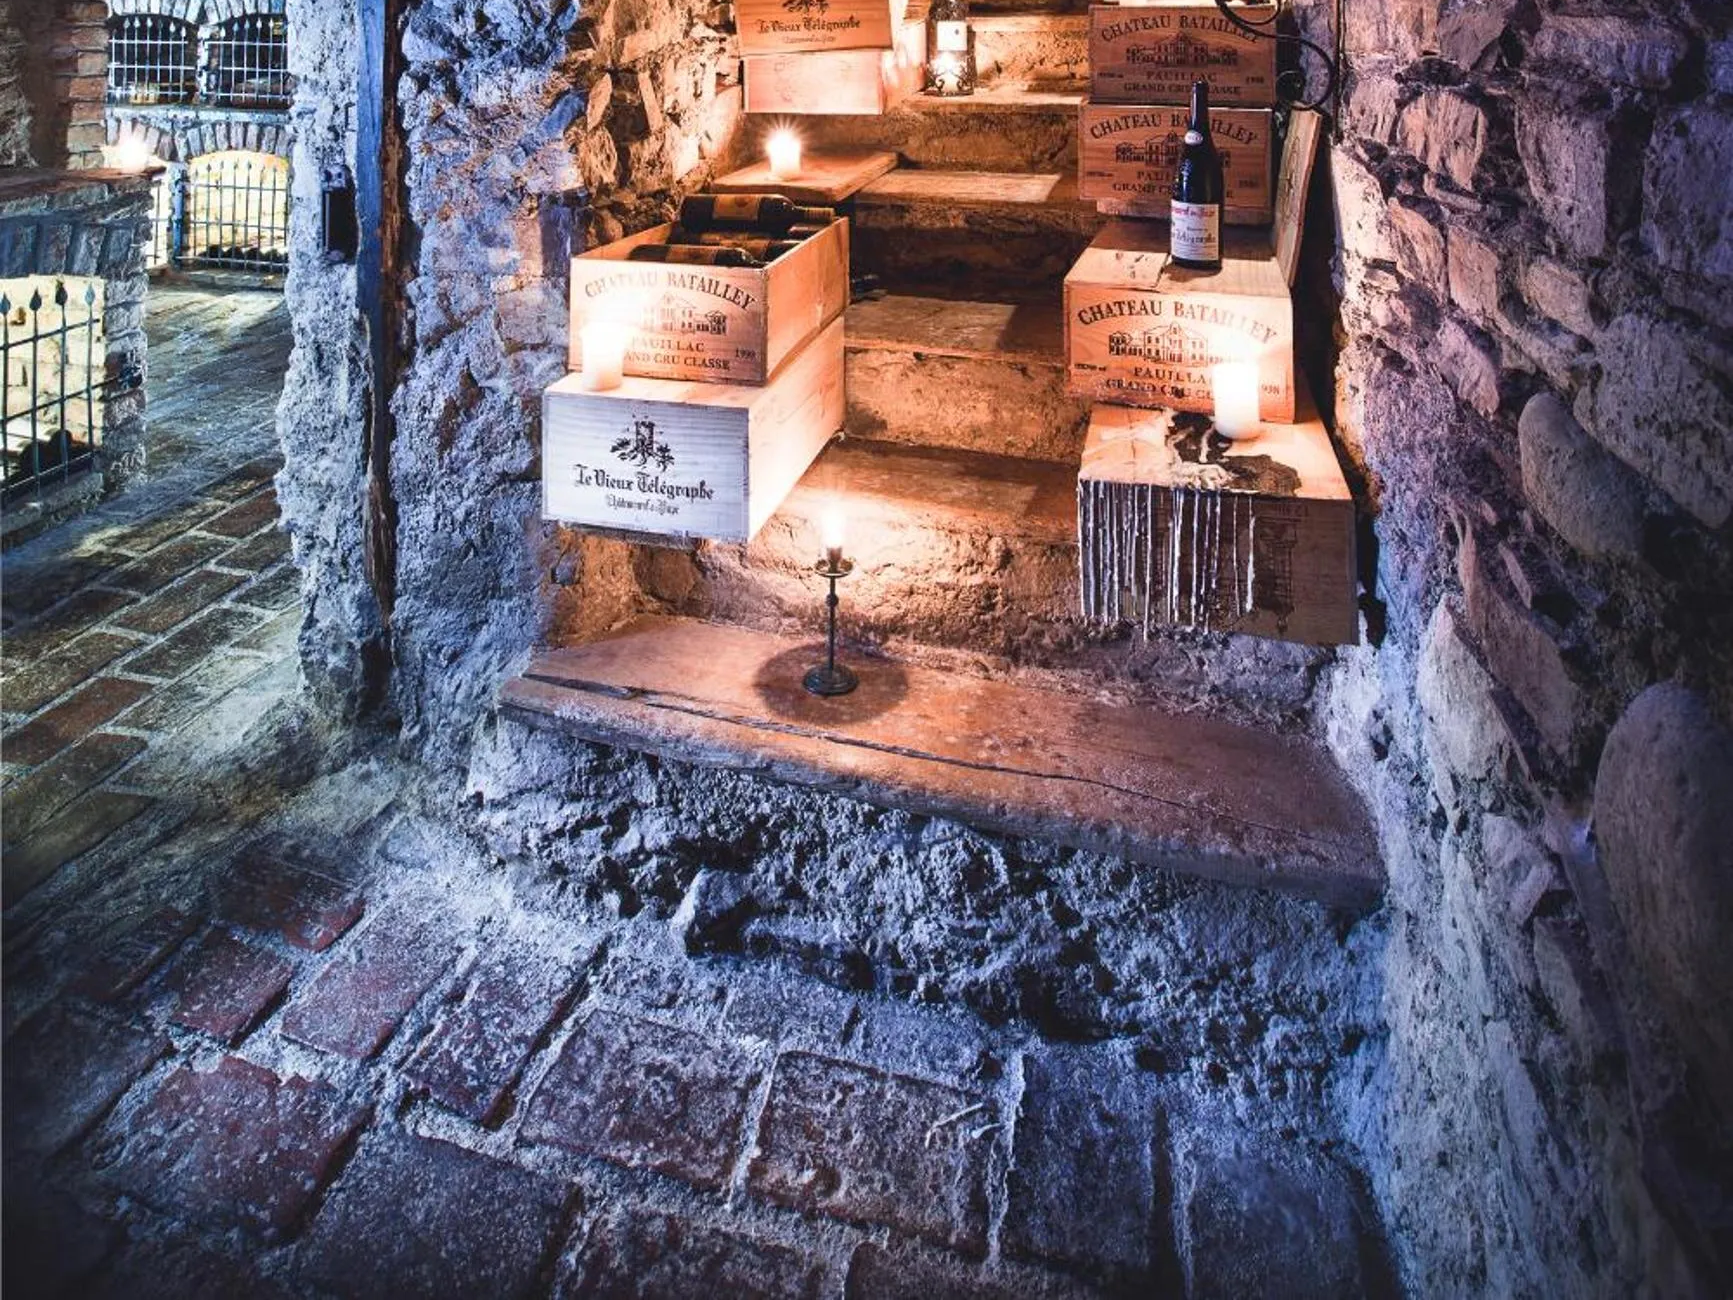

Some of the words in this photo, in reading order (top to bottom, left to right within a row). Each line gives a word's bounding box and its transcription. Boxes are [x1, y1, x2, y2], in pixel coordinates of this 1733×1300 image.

[1101, 15, 1171, 42] CHATEAU
[1123, 83, 1166, 93] GRAND
[1207, 86, 1241, 96] LASSE
[1090, 113, 1162, 140] CHATEAU
[1171, 114, 1259, 145] BAILLEY
[666, 271, 756, 312] BATAILLEY
[1077, 299, 1163, 326] CHATEAU
[1173, 300, 1278, 345] BATAILLEY
[654, 352, 681, 366] CRU
[683, 356, 731, 371] CLASSE
[1133, 366, 1207, 386] PAUILLA
[634, 471, 714, 503] Télégraphe
